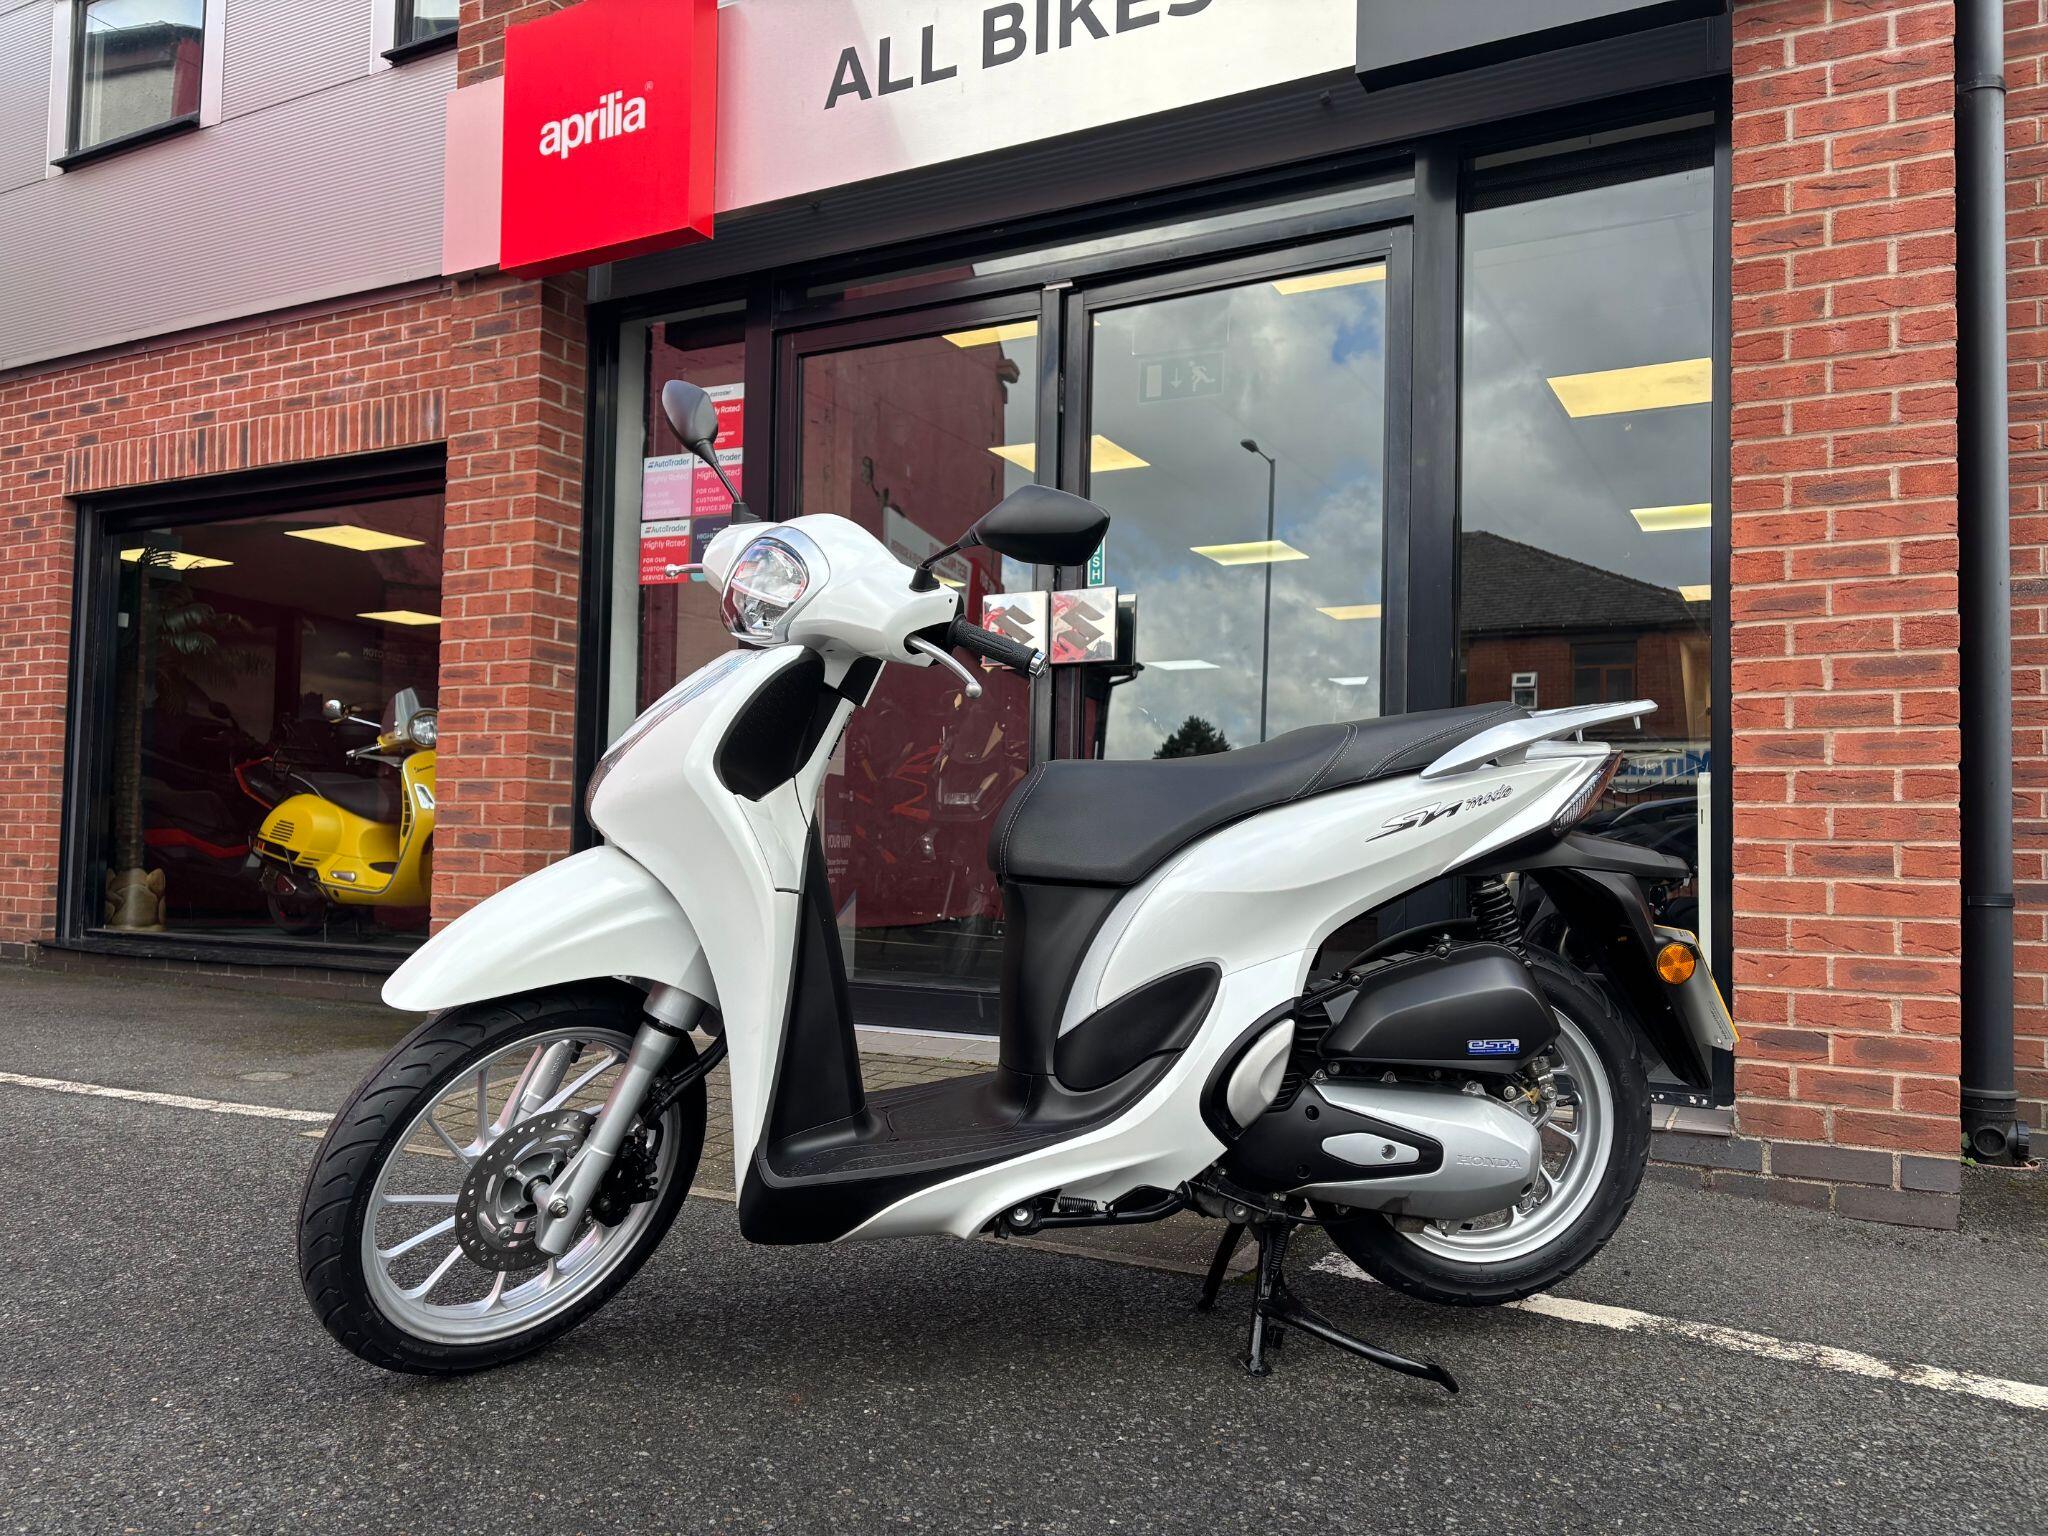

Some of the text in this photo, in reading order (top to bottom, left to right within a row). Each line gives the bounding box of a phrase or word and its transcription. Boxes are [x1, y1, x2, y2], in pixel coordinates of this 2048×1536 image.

[824, 0, 1211, 110] ALL BIKE
[539, 89, 646, 160] aprilia
[653, 458, 690, 469] AutoTrader
[696, 495, 725, 503] CUSTOMER
[695, 504, 718, 512] SERVICE
[651, 524, 687, 533] AutoTrader
[643, 538, 686, 550] Highly Rated
[1465, 783, 1514, 812] mode
[1456, 1153, 1522, 1169] HONDA
